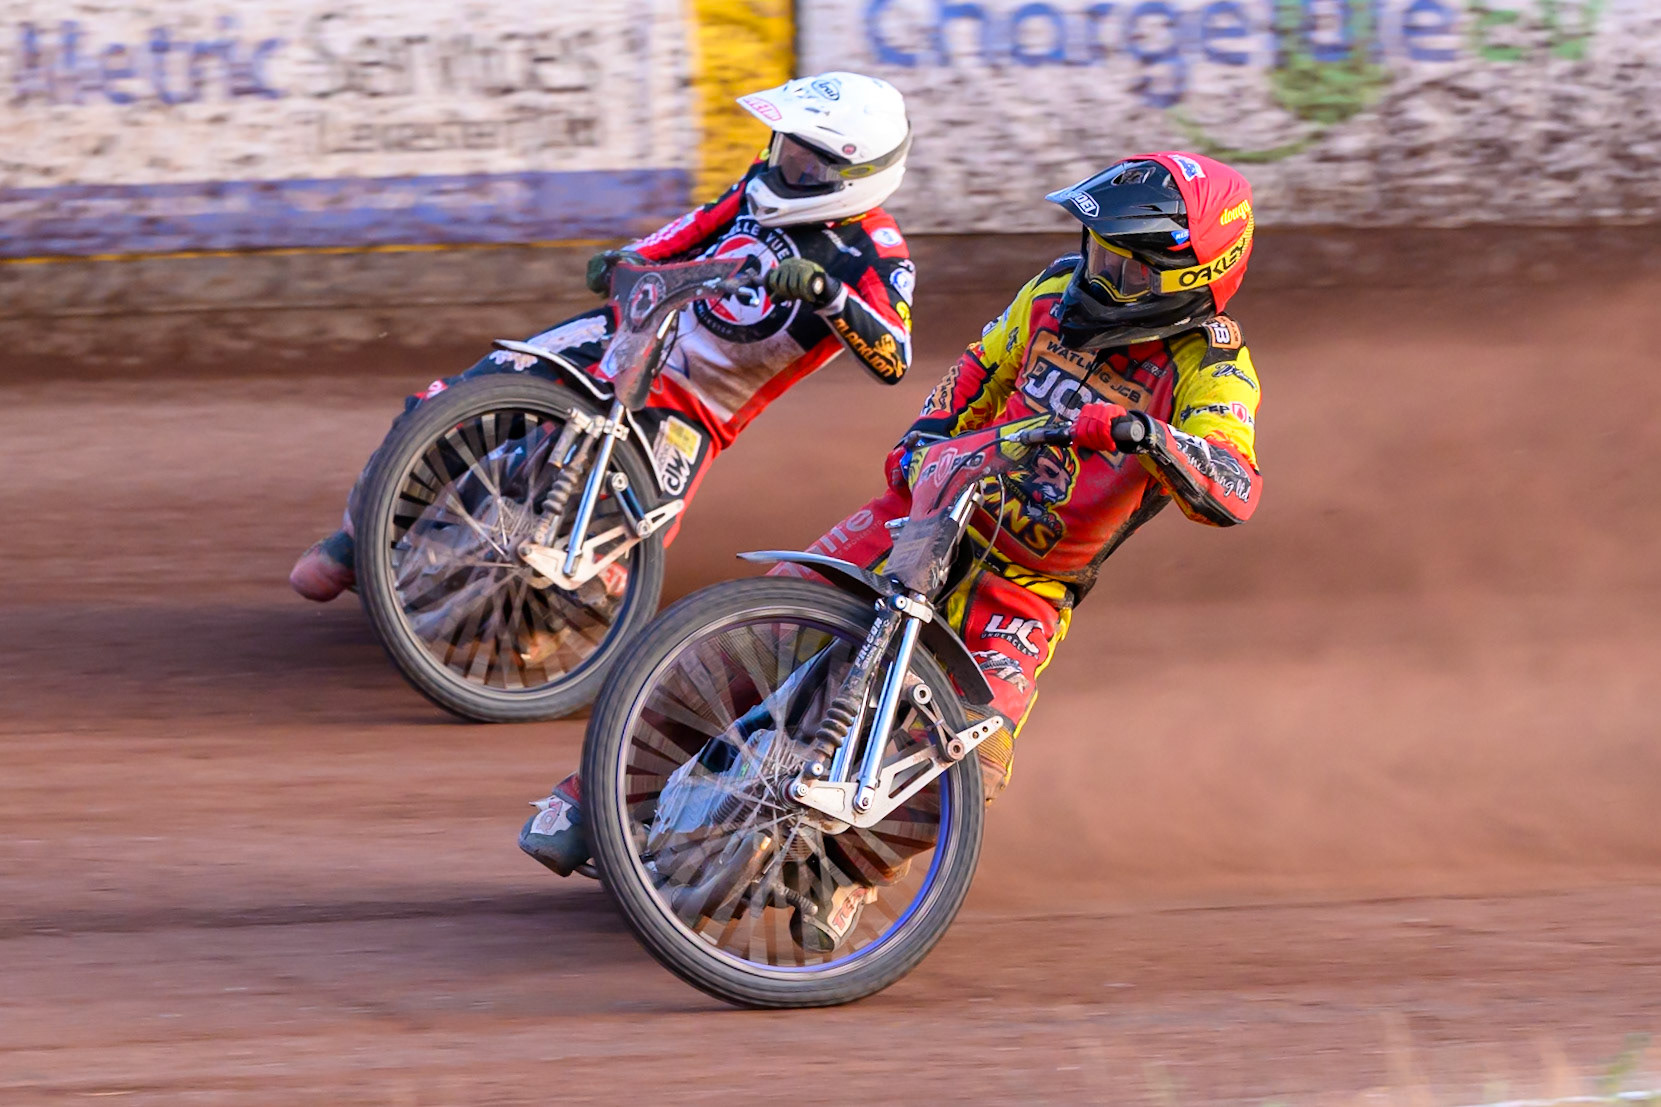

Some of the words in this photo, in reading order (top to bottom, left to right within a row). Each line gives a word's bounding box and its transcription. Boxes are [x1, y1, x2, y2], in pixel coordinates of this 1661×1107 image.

[1063, 190, 1098, 214] OEI
[1179, 238, 1246, 287] OAKLEY
[1024, 369, 1104, 423] JC
[1047, 341, 1111, 384] WATLIG
[1110, 383, 1142, 404] JCB
